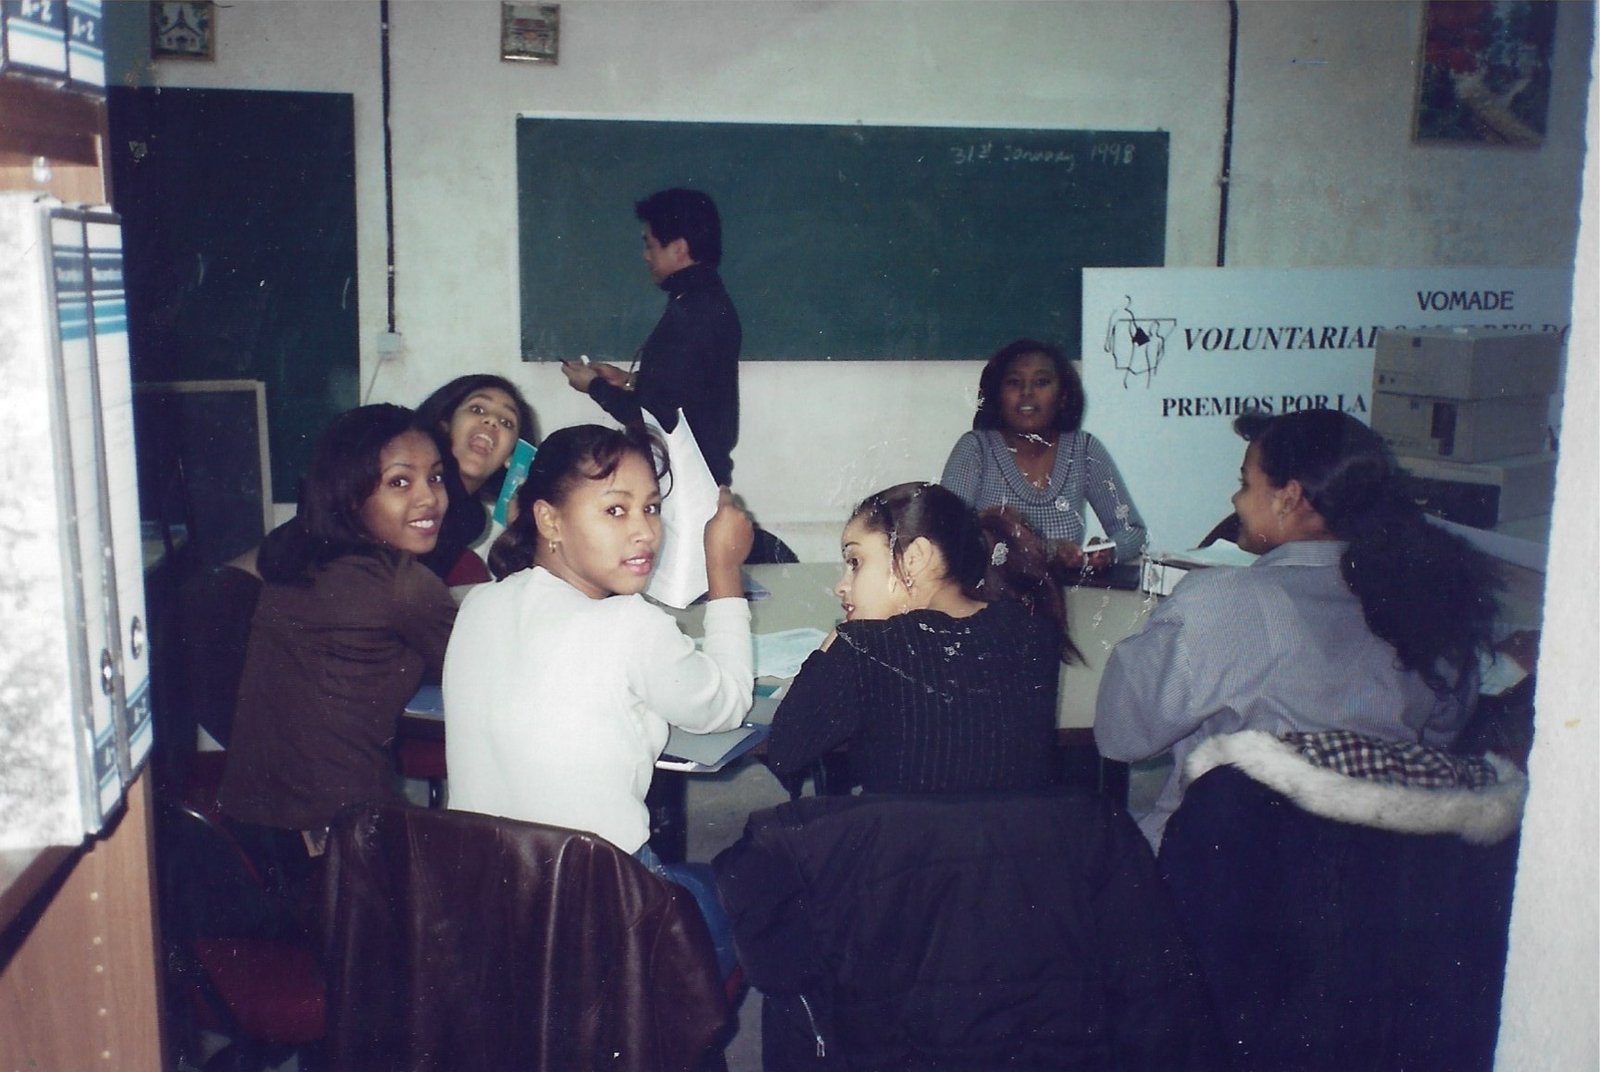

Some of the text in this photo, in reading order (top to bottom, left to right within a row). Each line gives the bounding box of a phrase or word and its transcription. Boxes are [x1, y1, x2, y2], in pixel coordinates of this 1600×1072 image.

[1090, 143, 1136, 165] 1998
[1417, 291, 1514, 312] VOMADE
[1162, 395, 1273, 417] PREMIOS
[1335, 393, 1367, 414] LA
